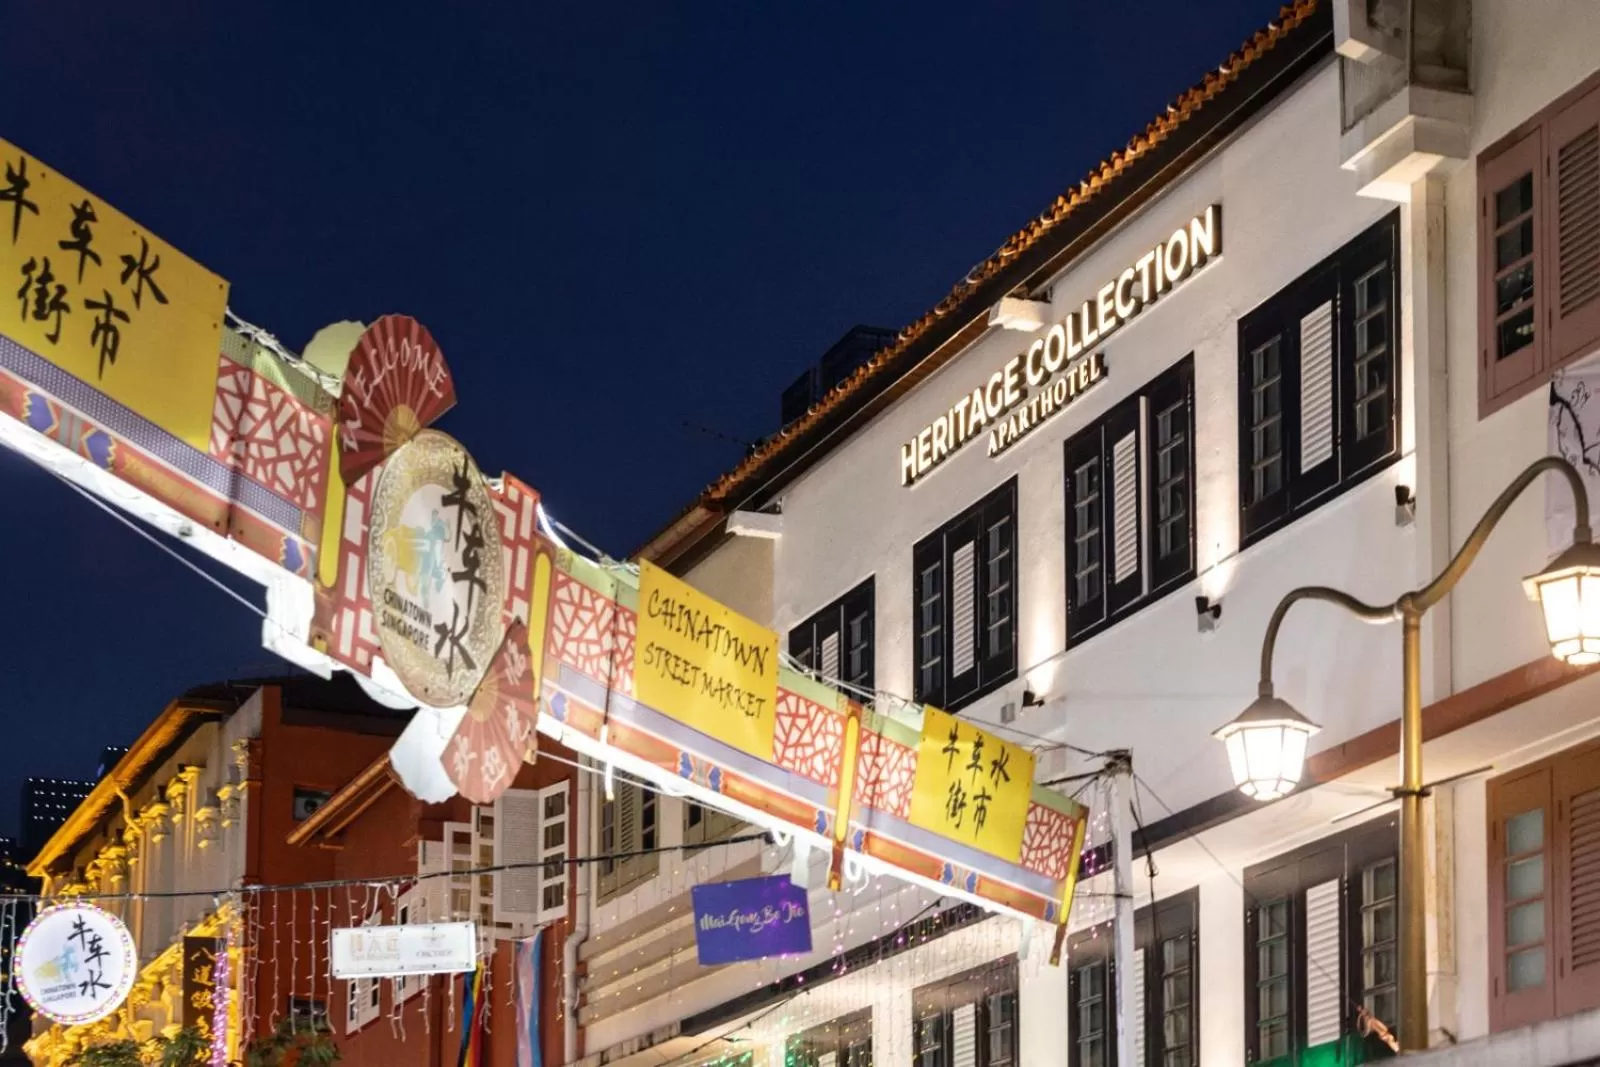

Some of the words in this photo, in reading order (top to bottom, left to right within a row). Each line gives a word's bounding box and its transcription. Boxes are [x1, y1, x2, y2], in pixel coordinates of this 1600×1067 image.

[18, 257, 130, 380] 街市
[901, 355, 1027, 487] HERITAGE
[1026, 204, 1221, 386] COLLECTION
[342, 337, 448, 452] WELCOME
[988, 353, 1108, 456] APARTHOTEL
[381, 610, 430, 651] SINGAPORE
[384, 588, 432, 628] CHINATOWN
[648, 589, 769, 677] CHINATOWN
[643, 641, 701, 688] STREET
[701, 672, 766, 719] MARKET
[945, 779, 992, 840] 街市
